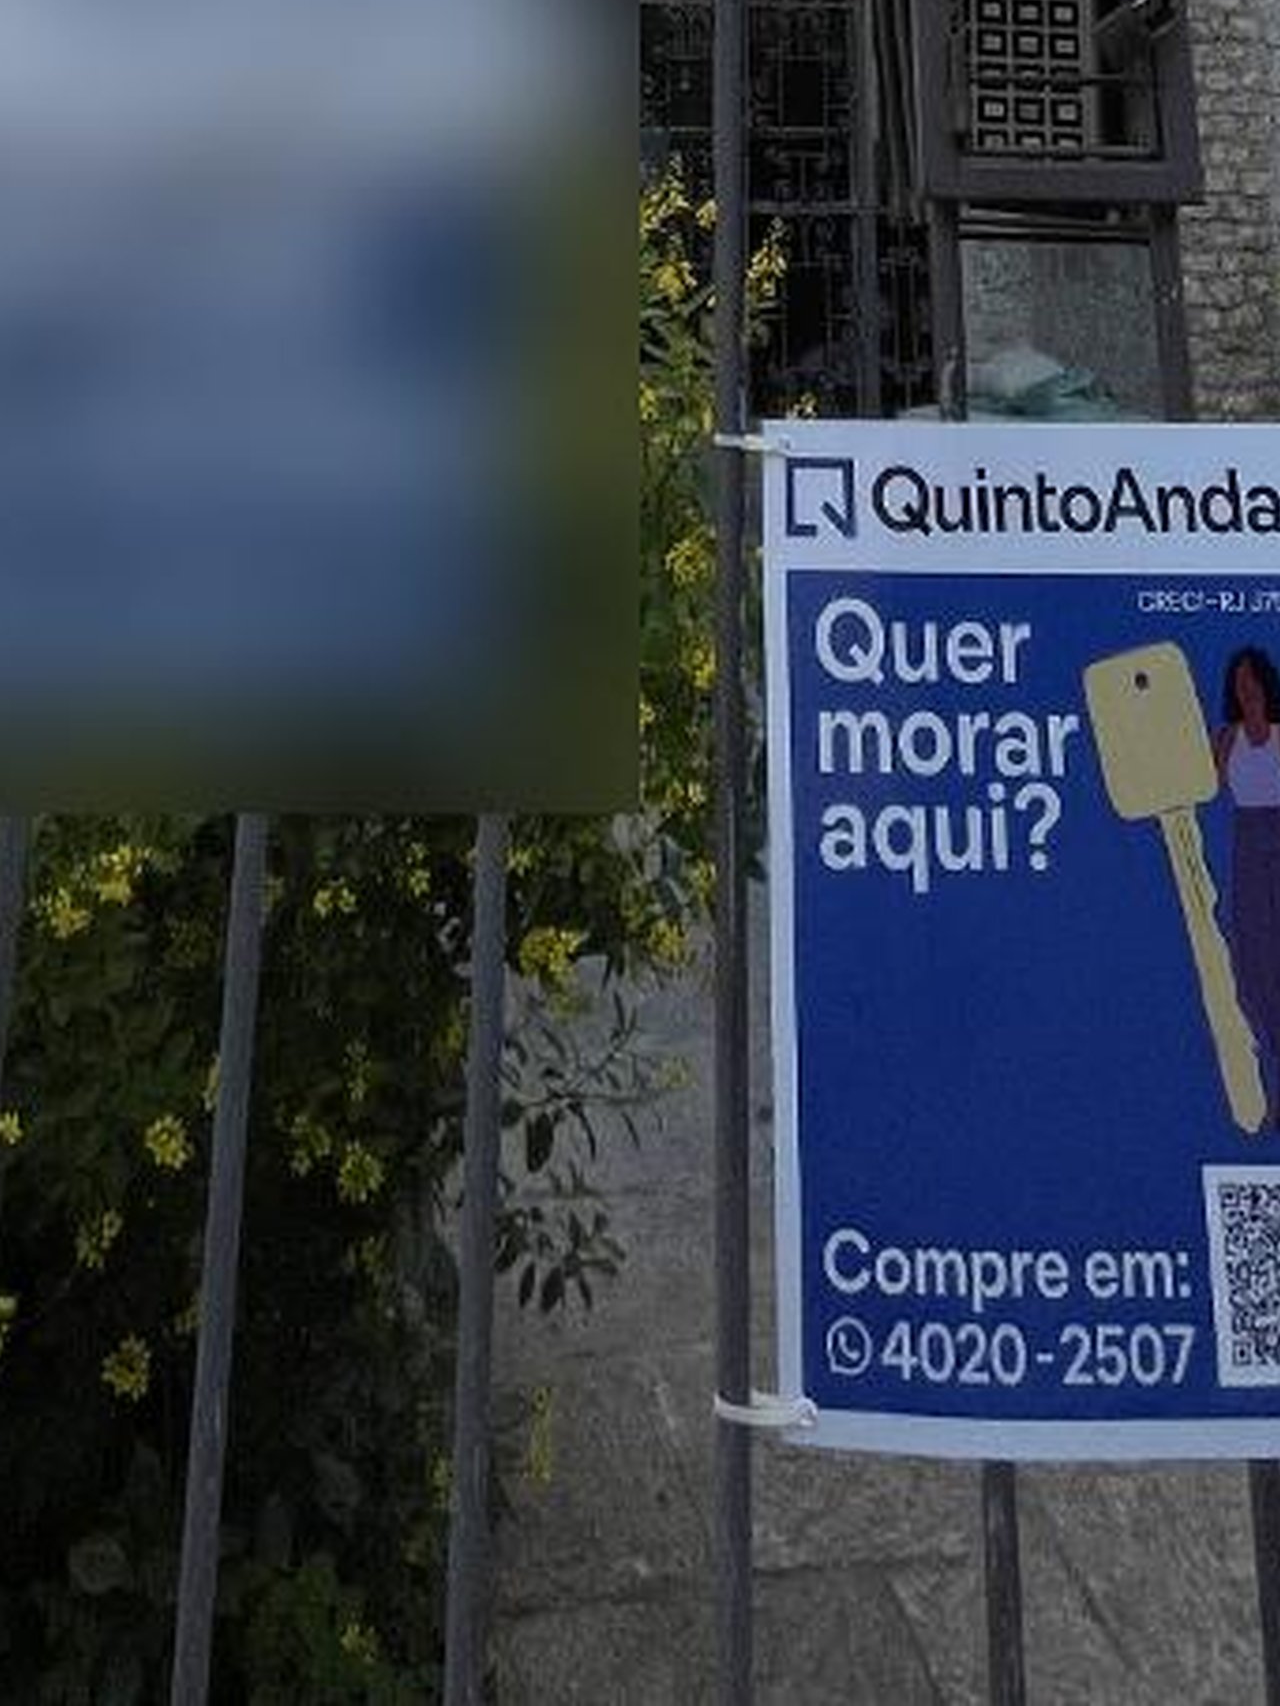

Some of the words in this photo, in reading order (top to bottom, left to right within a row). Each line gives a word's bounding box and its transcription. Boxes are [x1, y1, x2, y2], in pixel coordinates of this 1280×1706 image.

[815, 597, 1030, 685] Quer
[818, 709, 1081, 776] morar
[819, 784, 1061, 892] aqui?
[823, 1228, 1069, 1311] Compre
[1083, 1248, 1193, 1298] em:
[881, 1321, 1197, 1387] 4020-2507
